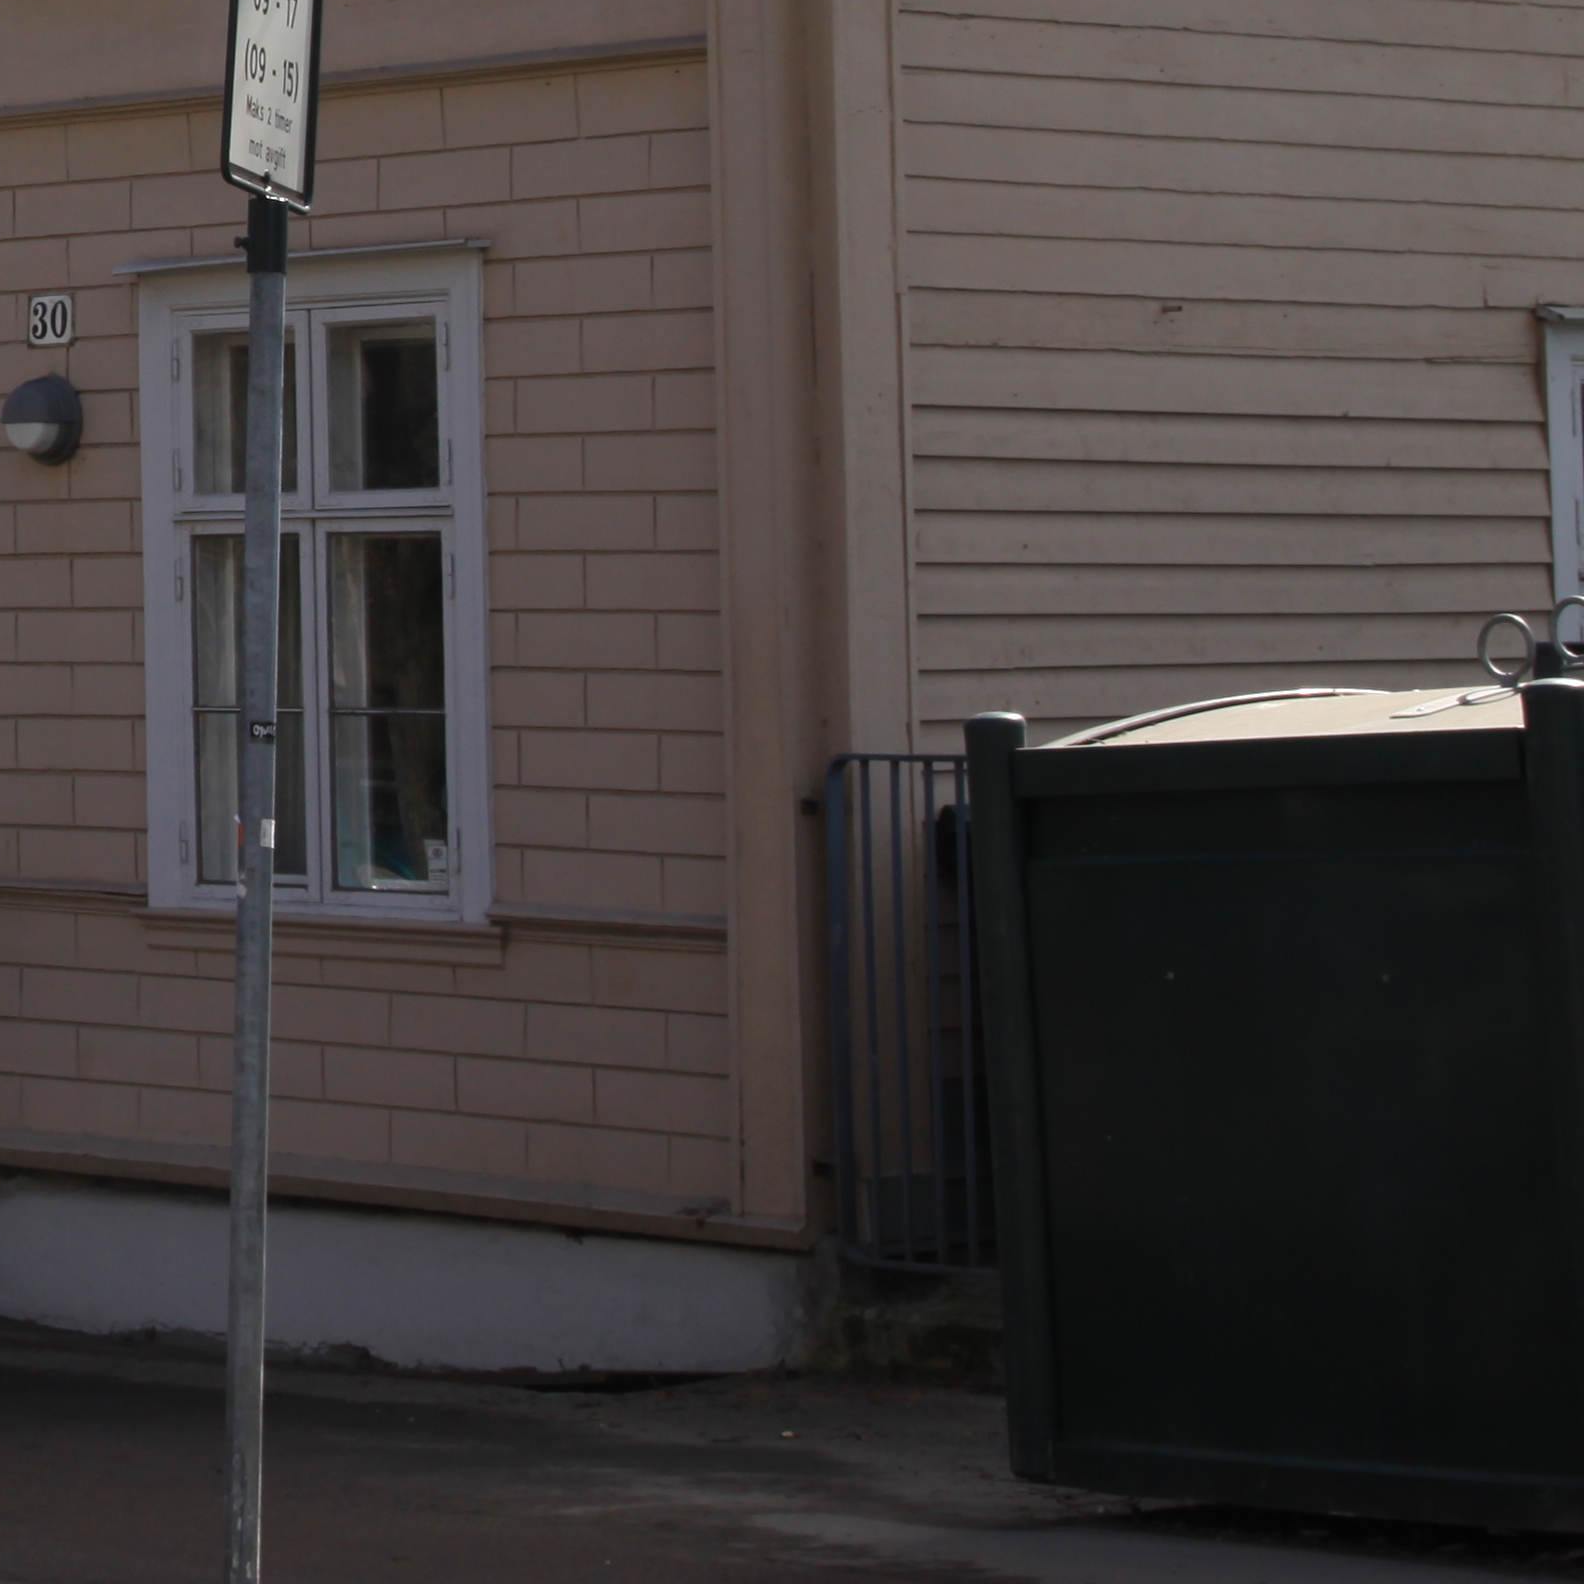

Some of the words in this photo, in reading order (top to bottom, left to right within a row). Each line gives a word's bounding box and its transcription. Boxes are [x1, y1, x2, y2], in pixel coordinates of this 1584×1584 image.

[244, 38, 266, 84] (09
[282, 59, 299, 104] 15)
[246, 94, 264, 122] Maks
[267, 106, 272, 126] 2
[274, 108, 293, 134] timer
[249, 138, 263, 159] mot
[265, 146, 286, 171] avgift
[32, 301, 68, 340] 30
